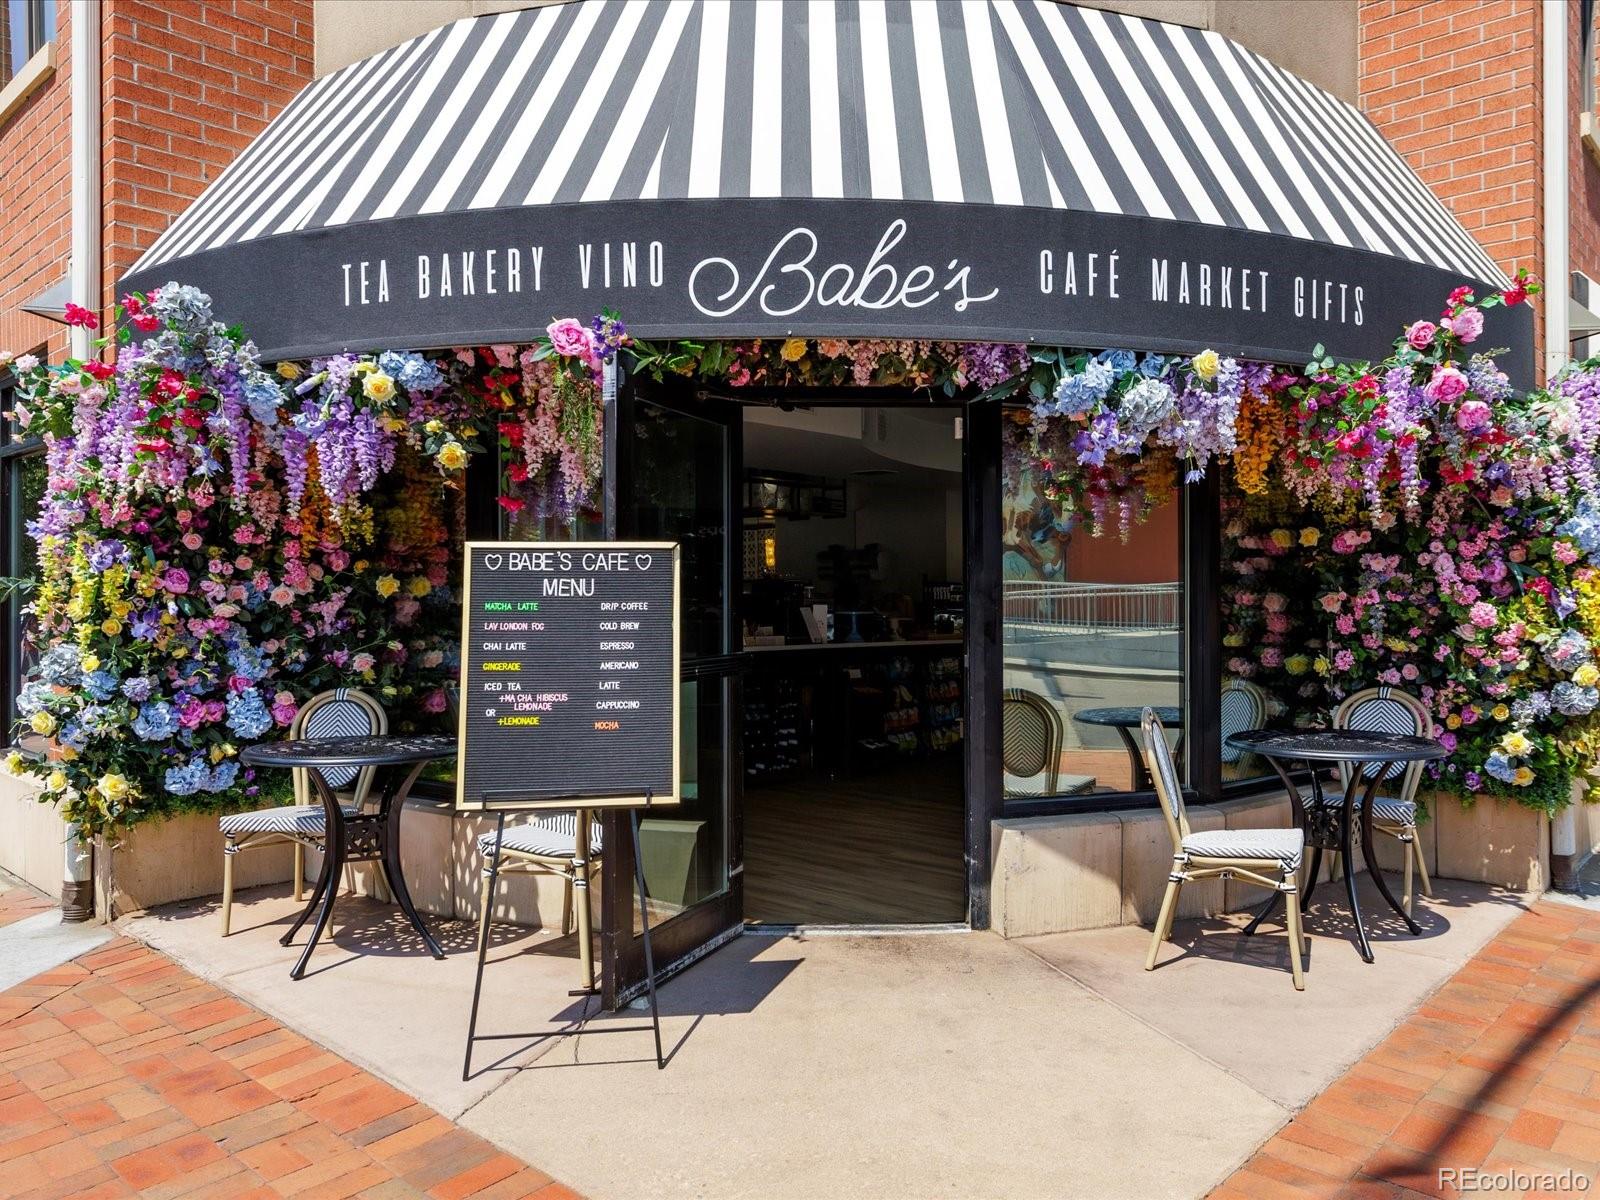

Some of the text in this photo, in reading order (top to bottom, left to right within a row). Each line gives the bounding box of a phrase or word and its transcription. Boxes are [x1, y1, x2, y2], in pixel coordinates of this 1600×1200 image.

[689, 218, 999, 318] Babe's
[341, 240, 664, 307] TEA BAKERY VINO
[1040, 248, 1365, 327] CAFÉ MARKET GIFTS
[508, 552, 630, 571] BABE'S CAFE
[542, 578, 595, 597] MENU
[484, 602, 539, 611] MATCHA LATTE
[600, 602, 649, 611] DRIP COFFEE
[499, 622, 528, 631] LONDON
[531, 622, 545, 631] FOG
[599, 622, 640, 631] COLD BREW
[483, 642, 527, 651] CHAI LATTE
[600, 642, 635, 651] ESPRESSO
[599, 661, 639, 671] AMERICANO
[484, 682, 521, 691] ICED TEA
[599, 681, 621, 690] LATTE
[536, 693, 569, 702] HIBISCUS
[513, 702, 553, 711] LEMONADE
[596, 701, 640, 710] CAPPUCCINO
[485, 708, 496, 717] OR
[594, 721, 620, 730] MOCHA
